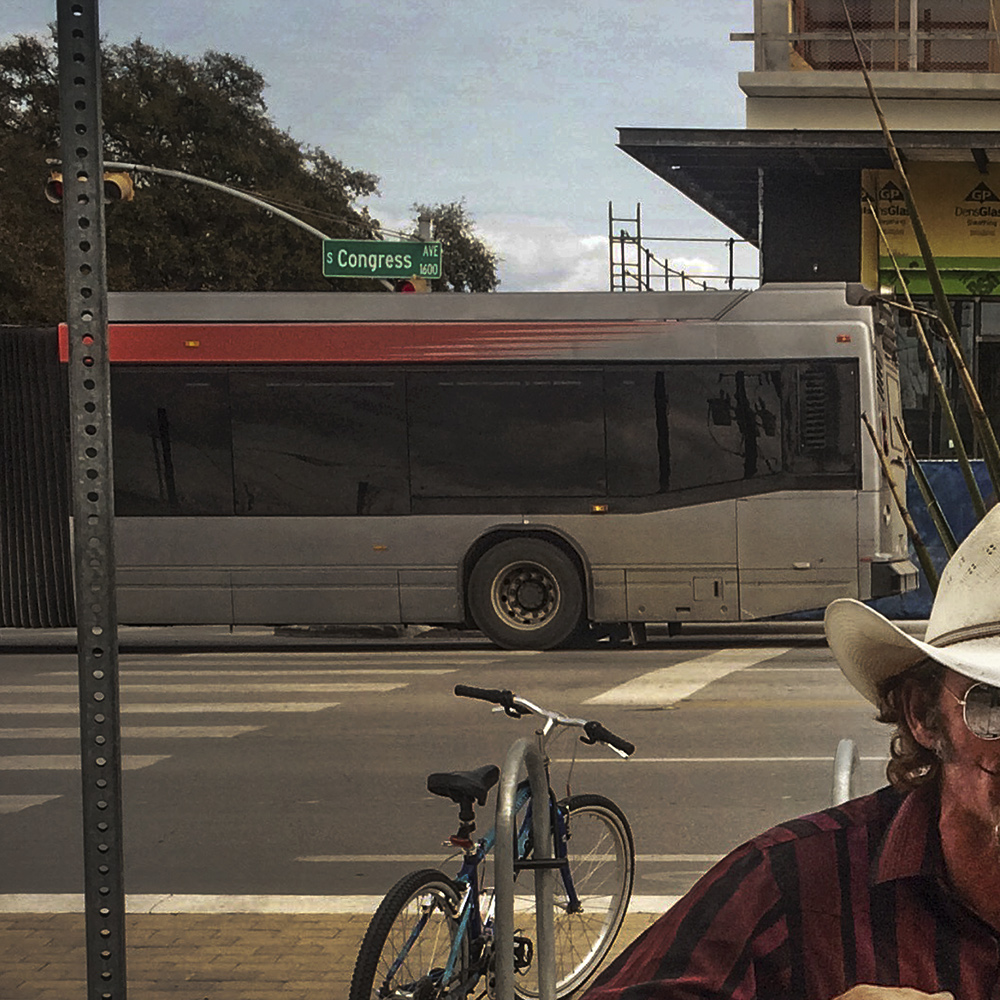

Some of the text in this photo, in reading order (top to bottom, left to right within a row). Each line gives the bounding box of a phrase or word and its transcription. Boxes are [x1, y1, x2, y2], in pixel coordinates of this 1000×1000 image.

[881, 189, 900, 199] GP
[971, 189, 992, 200] GP
[422, 244, 439, 257] AVE
[326, 248, 413, 272] S Congress
[419, 263, 438, 275] 1600
